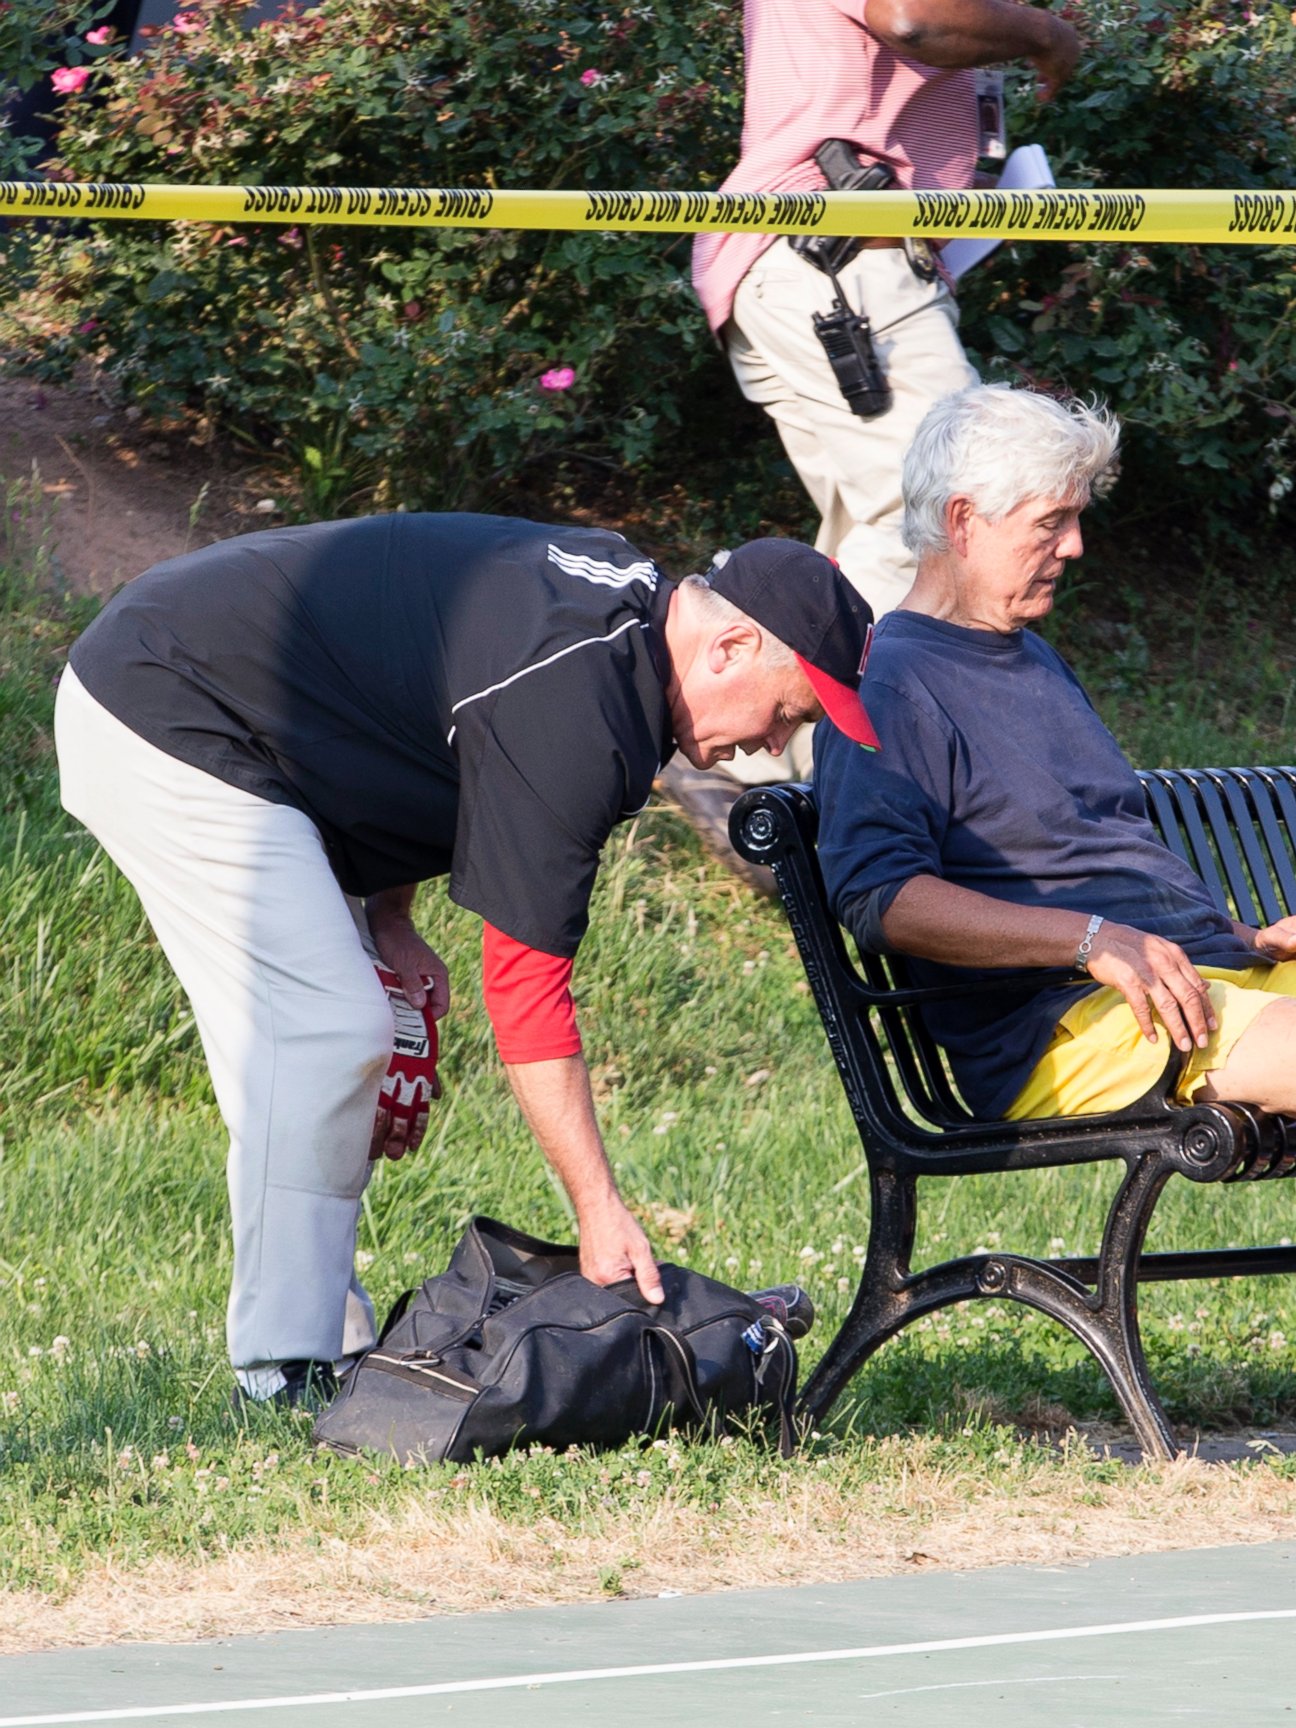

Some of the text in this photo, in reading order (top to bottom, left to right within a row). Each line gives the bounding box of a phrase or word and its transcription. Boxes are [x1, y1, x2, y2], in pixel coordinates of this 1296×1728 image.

[22, 182, 82, 208] SCENE
[84, 183, 146, 209] CRIME
[244, 187, 493, 219] CRIME SCENE DO NOT CROSS
[585, 192, 826, 226] CRIME SCENE DO NOT CROSS
[912, 192, 1146, 231] CRIME SCENE DO NOT CROSS
[1228, 194, 1284, 232] CROSS
